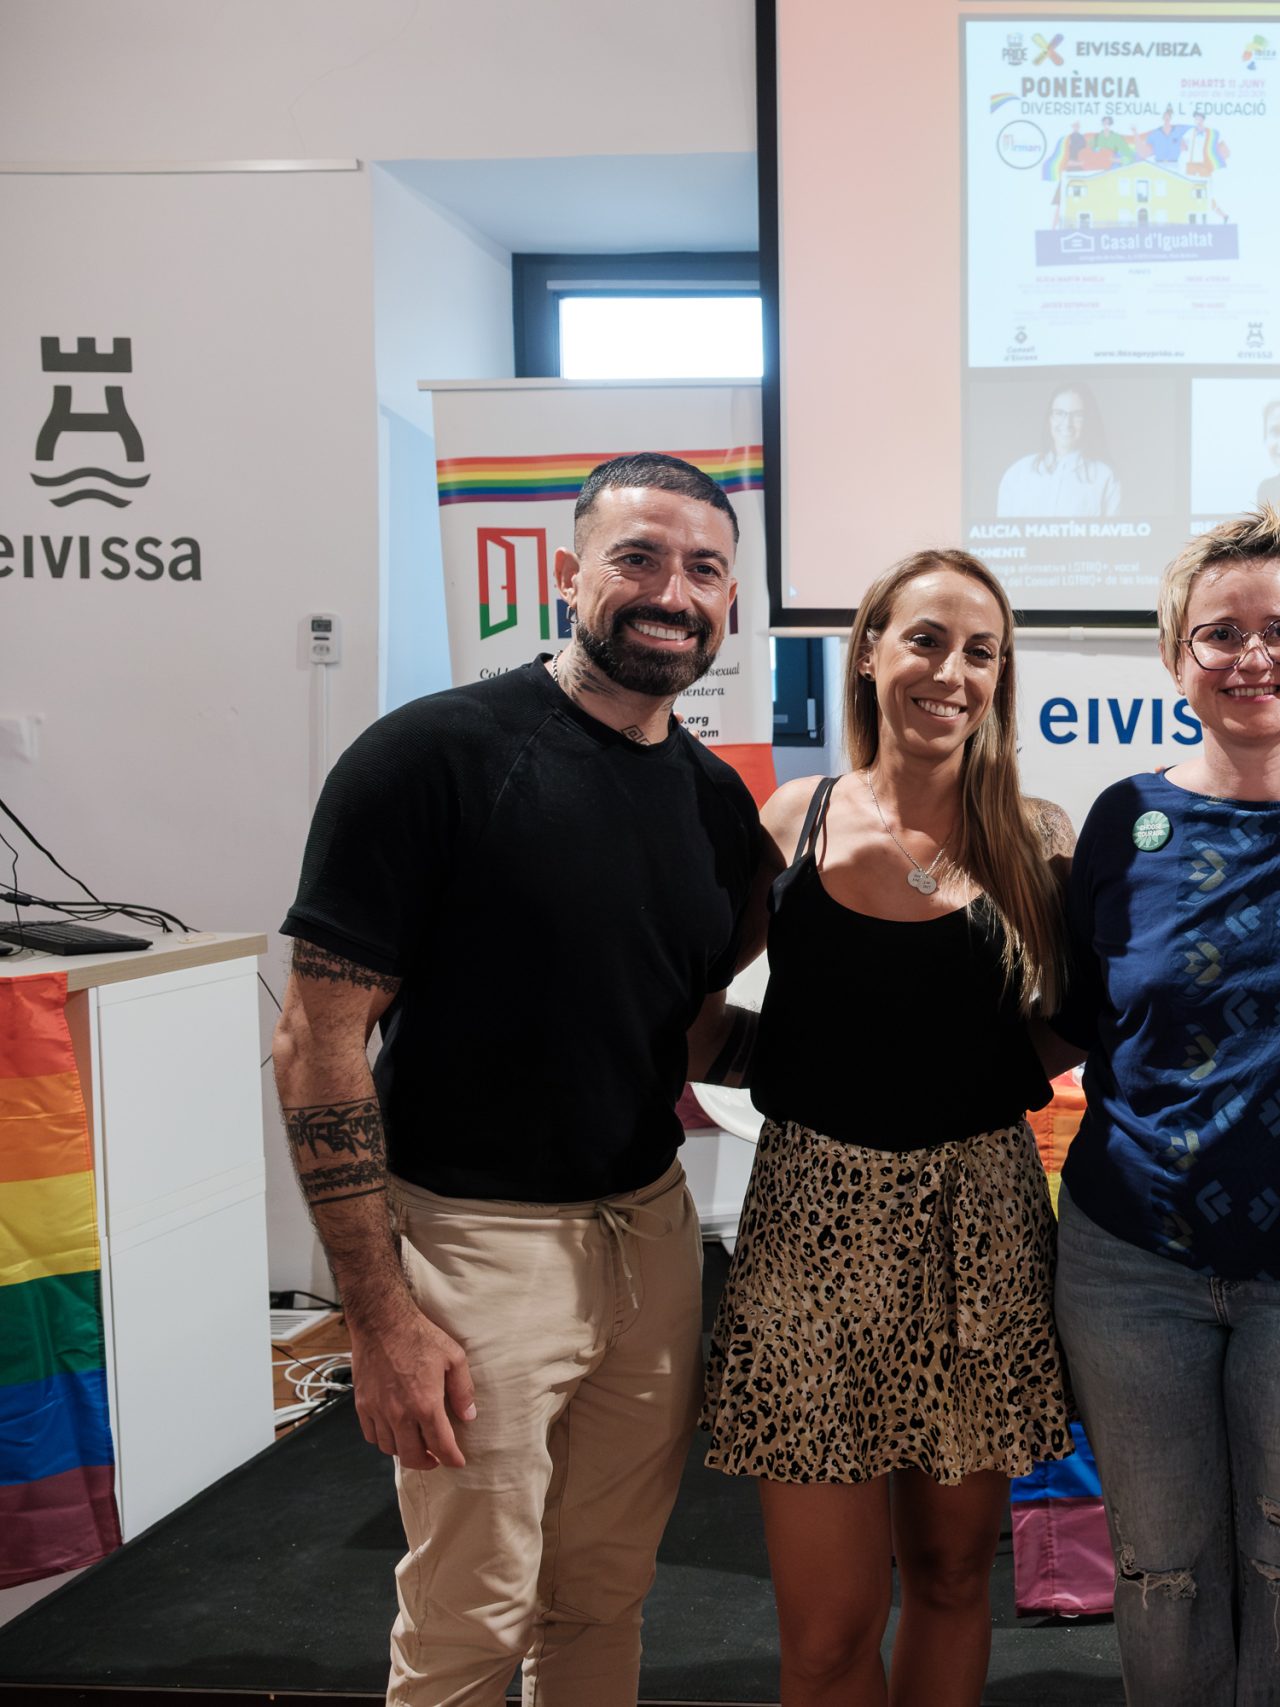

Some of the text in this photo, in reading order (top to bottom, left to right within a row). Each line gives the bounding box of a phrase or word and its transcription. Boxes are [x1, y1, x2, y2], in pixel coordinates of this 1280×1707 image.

[1076, 41, 1202, 57] EIVISSA/IBIZA
[1021, 70, 1140, 98] PONÈNCIA
[1021, 101, 1101, 116] DIVERSITAT
[1105, 101, 1159, 115] SEXUAL
[1100, 231, 1214, 252] Casal d'Igualtat
[969, 520, 1151, 539] ALICIA MARTÍN RAVELO
[1039, 697, 1203, 746] eivis
